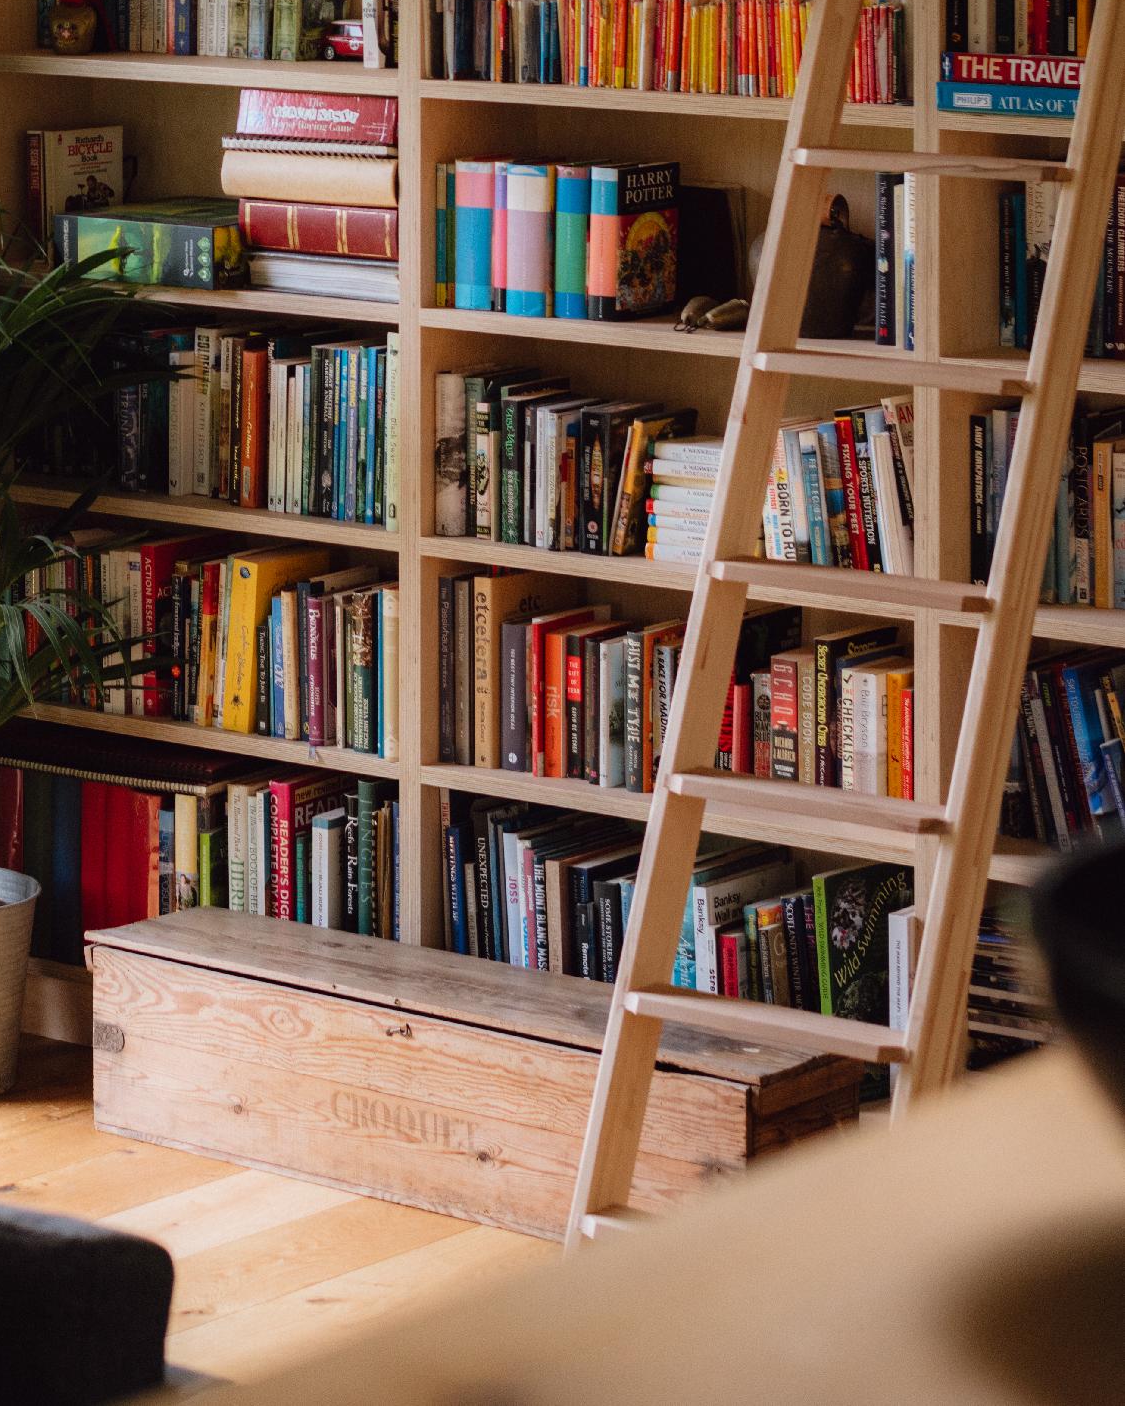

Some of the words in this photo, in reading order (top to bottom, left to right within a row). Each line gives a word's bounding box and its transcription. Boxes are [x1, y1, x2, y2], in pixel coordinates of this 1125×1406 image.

[957, 55, 1004, 81] THE
[997, 97, 1045, 112] ATLAS
[1045, 98, 1068, 113] OF
[67, 141, 113, 156] BICYCLE
[81, 155, 98, 163] Book
[624, 184, 674, 204] POTTER
[626, 169, 673, 188] HARRY
[1116, 185, 1125, 227] FREEDOM
[1116, 228, 1125, 273] CLIMBERS
[1105, 246, 1114, 294] MOUNTAIN
[389, 417, 398, 439] Black
[974, 425, 983, 448] ANDY
[841, 443, 855, 480] FIXING
[858, 460, 871, 494] SPORTS
[974, 449, 985, 505] KIRKPATRICK
[776, 481, 792, 518] BORN
[845, 481, 857, 511] YOUR
[781, 521, 793, 538] TO
[848, 512, 860, 535] FEET
[861, 495, 876, 546] NUTRITION
[144, 557, 154, 596] ACTION
[519, 595, 542, 612] etc
[308, 608, 321, 661] Benedictus
[440, 601, 450, 653] Passivhaus
[474, 591, 491, 681] etcetera
[626, 638, 641, 671] JUST
[657, 648, 664, 656] A
[657, 656, 666, 678] RACE
[817, 644, 829, 672] SECRET
[546, 685, 561, 719] risk
[658, 679, 667, 699] FOR
[773, 664, 794, 716] GCHQ
[802, 676, 812, 708] CODE
[817, 672, 829, 724] UNDERGROUND
[1066, 678, 1075, 694] SKI
[626, 707, 640, 743] TYPE
[802, 712, 813, 747] BOOK
[817, 724, 829, 747] CITIES
[842, 697, 854, 772] CHECKLIST
[855, 710, 870, 748] Bryson
[269, 793, 279, 871] COMPLETE
[279, 819, 289, 886] READER'S
[347, 855, 358, 880] Rain
[358, 798, 374, 906] JUNGLES
[448, 834, 458, 883] MEETINGS
[269, 873, 279, 898] DIY
[477, 836, 490, 909] UNEXPECTED
[533, 864, 545, 882] THE
[346, 882, 358, 915] Forests
[450, 884, 458, 909] WITH
[508, 875, 519, 905] JOSS
[526, 874, 535, 911] patagonia
[534, 884, 546, 911] MONT
[713, 893, 742, 909] Banksy
[603, 897, 612, 924] SOME
[696, 898, 706, 935] Banksy
[804, 904, 816, 931] THE
[856, 872, 909, 958] swimming
[535, 914, 547, 945] BLANC
[604, 924, 613, 963] STORIES
[818, 921, 827, 940] WILD
[580, 942, 590, 975] Remote
[818, 940, 828, 978] SWIMMING
[833, 952, 862, 989] wild
[821, 978, 829, 1000] GUIDE
